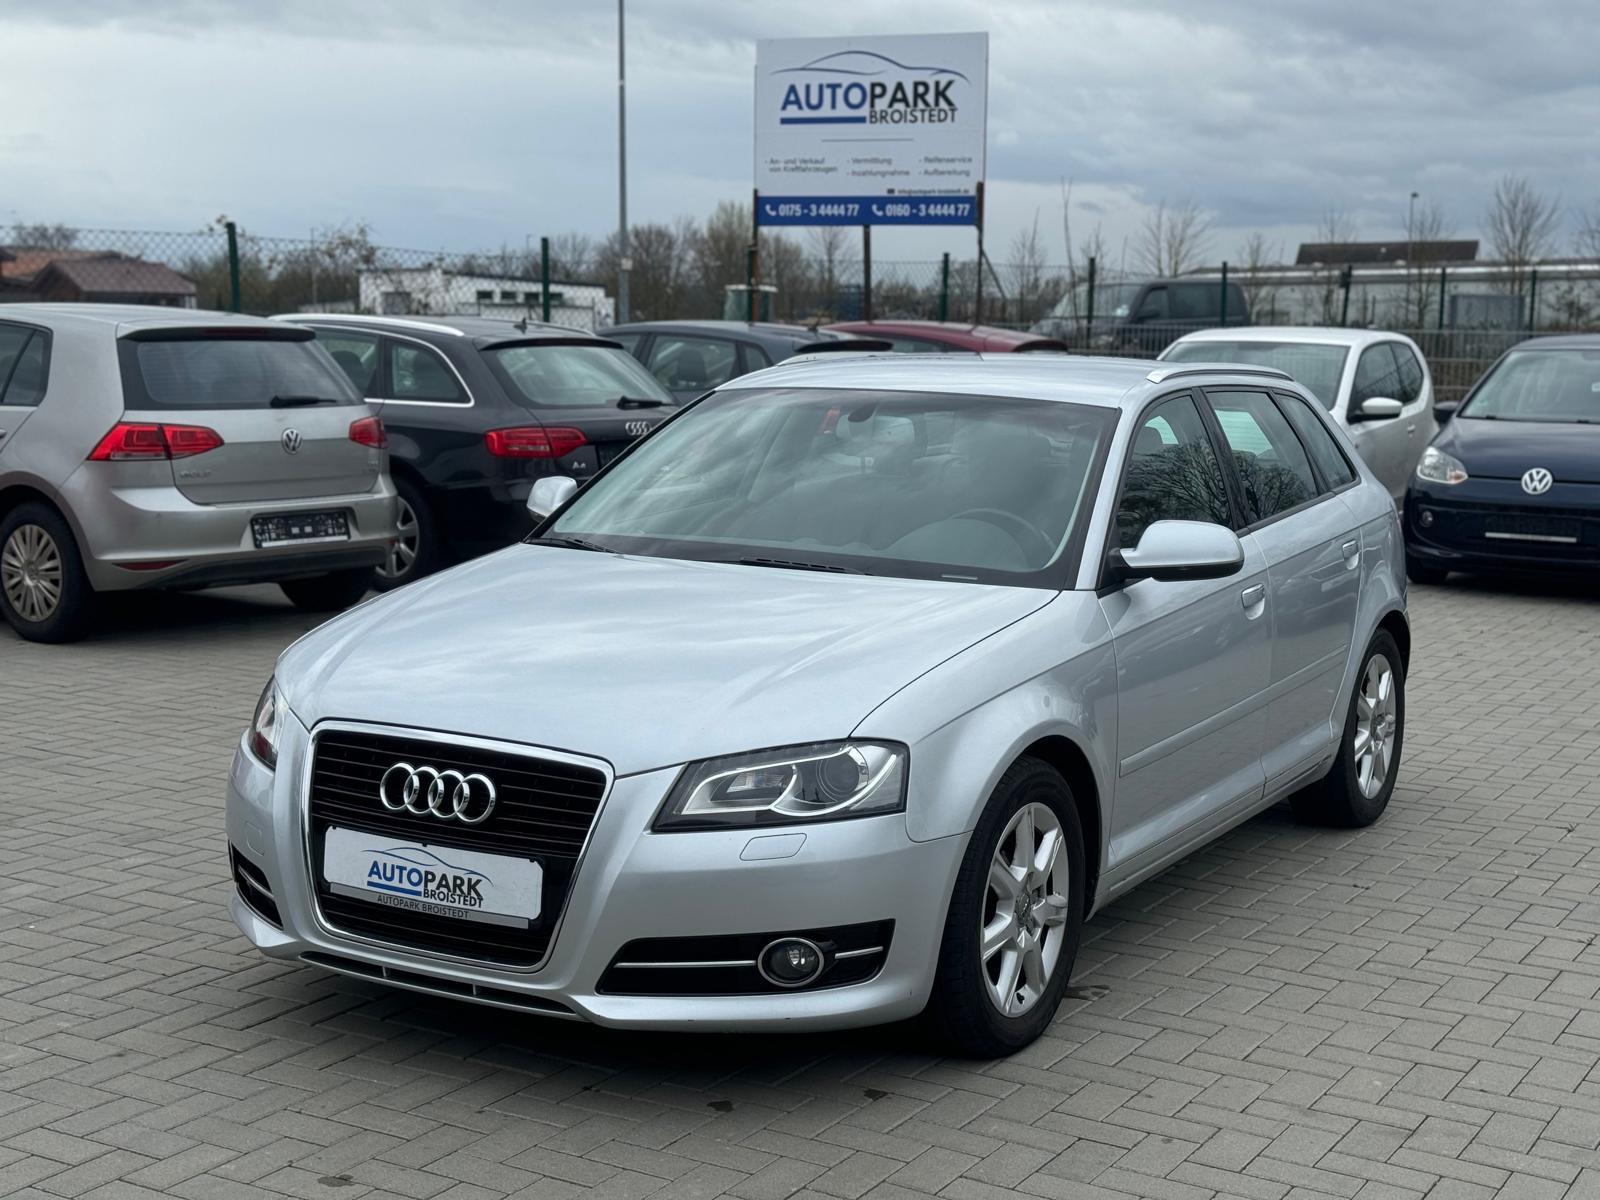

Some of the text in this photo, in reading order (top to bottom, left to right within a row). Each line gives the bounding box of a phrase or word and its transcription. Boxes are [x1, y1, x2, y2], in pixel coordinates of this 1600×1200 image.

[780, 79, 956, 111] AUTOPARK
[869, 107, 958, 125] BROISTEDT
[778, 203, 802, 217] 0175
[885, 203, 911, 217] 0160
[367, 860, 483, 898] AUTOPARK
[377, 895, 470, 919] AUTOPARK BROISTEDT
[423, 888, 484, 908] BROISTEDT
